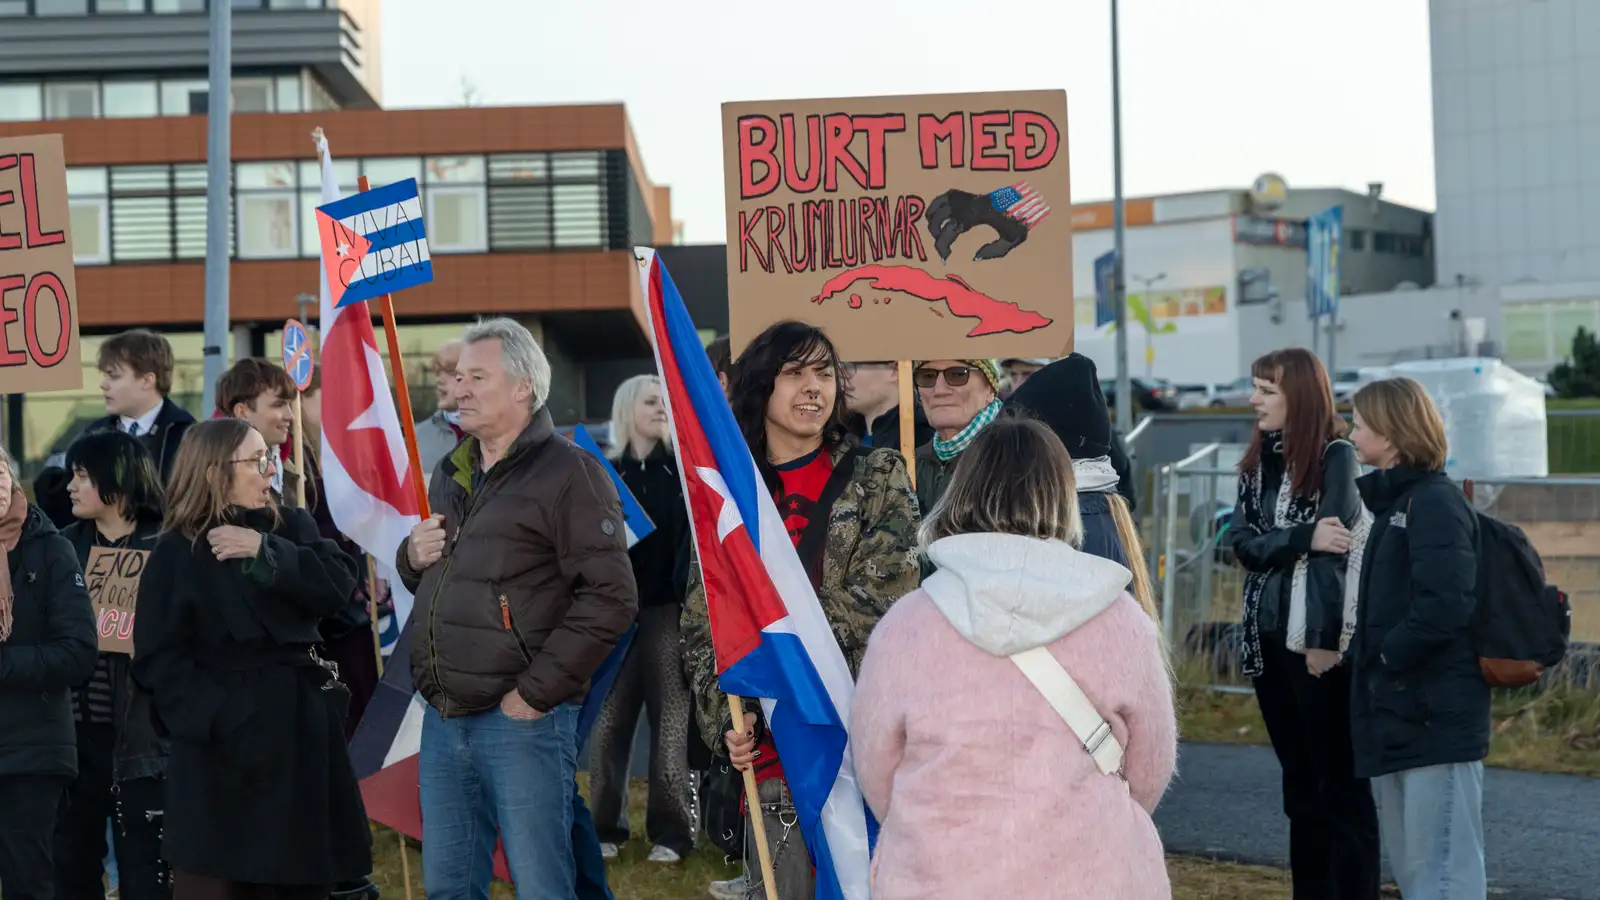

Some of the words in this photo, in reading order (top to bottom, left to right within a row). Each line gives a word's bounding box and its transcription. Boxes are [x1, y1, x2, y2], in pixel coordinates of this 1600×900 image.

[737, 113, 906, 200] BURT
[339, 236, 424, 290] CUBA!
[738, 194, 927, 273] KRUMLURNAR
[88, 550, 144, 579] END
